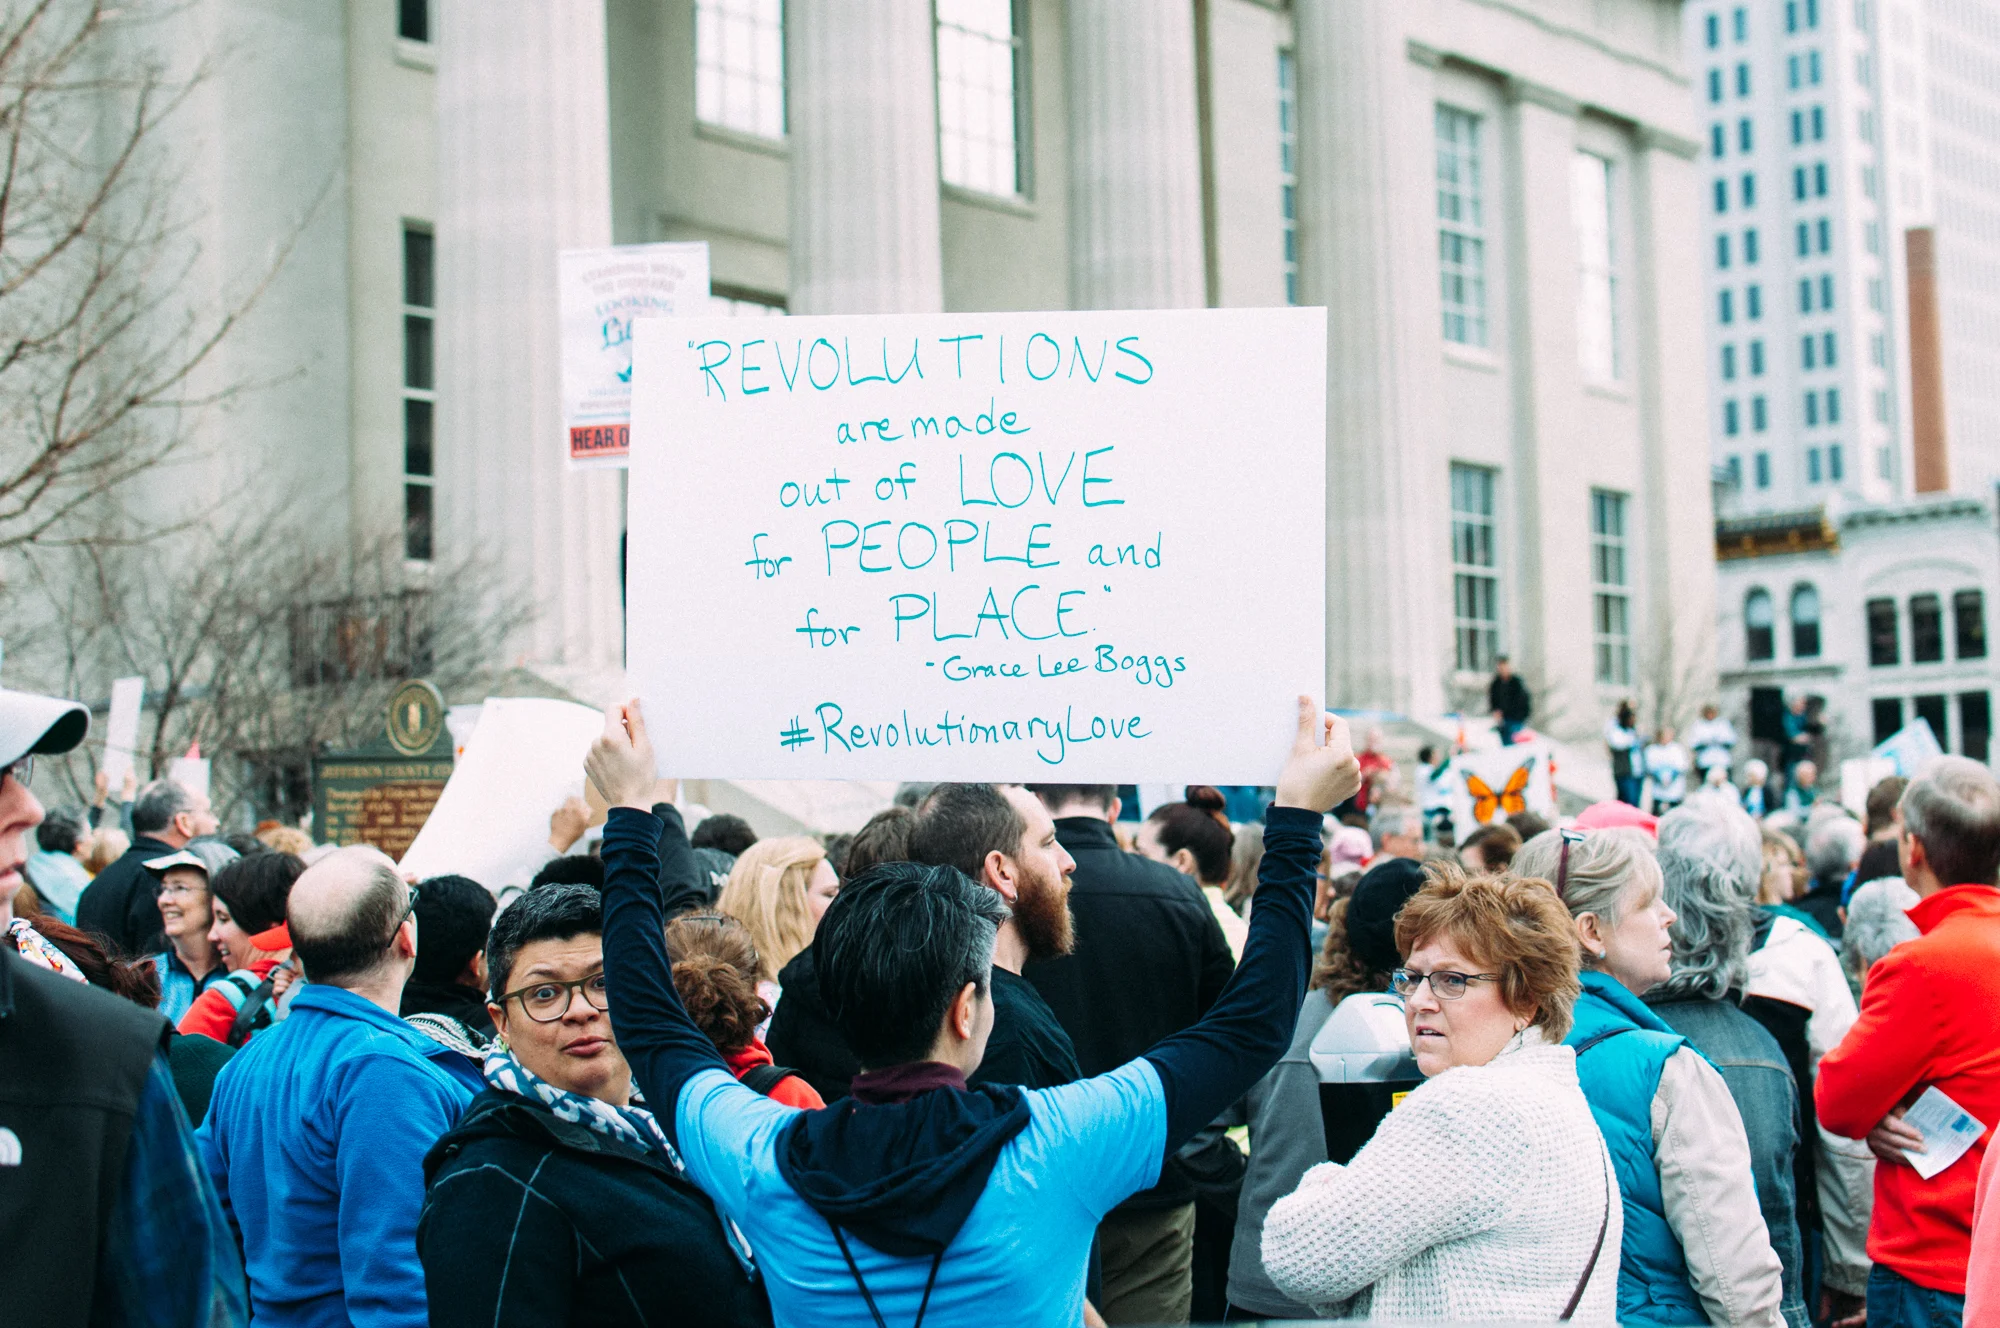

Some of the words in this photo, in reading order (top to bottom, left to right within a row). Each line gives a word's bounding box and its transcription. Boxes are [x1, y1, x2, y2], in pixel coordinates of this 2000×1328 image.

[687, 333, 1154, 402] "REVOLUTIONS
[573, 427, 615, 451] HEAR
[837, 417, 903, 443] are
[911, 397, 1031, 439] made
[779, 469, 851, 508] out
[875, 462, 917, 501] of
[959, 446, 1126, 509] LOVE
[744, 532, 793, 580] for
[820, 519, 1061, 574] PEOPLE
[1087, 531, 1162, 569] and
[795, 608, 861, 648] for
[1037, 654, 1088, 679] Lee
[1094, 643, 1187, 689] Boggs
[779, 701, 1153, 766] #RevolutionaryLove
